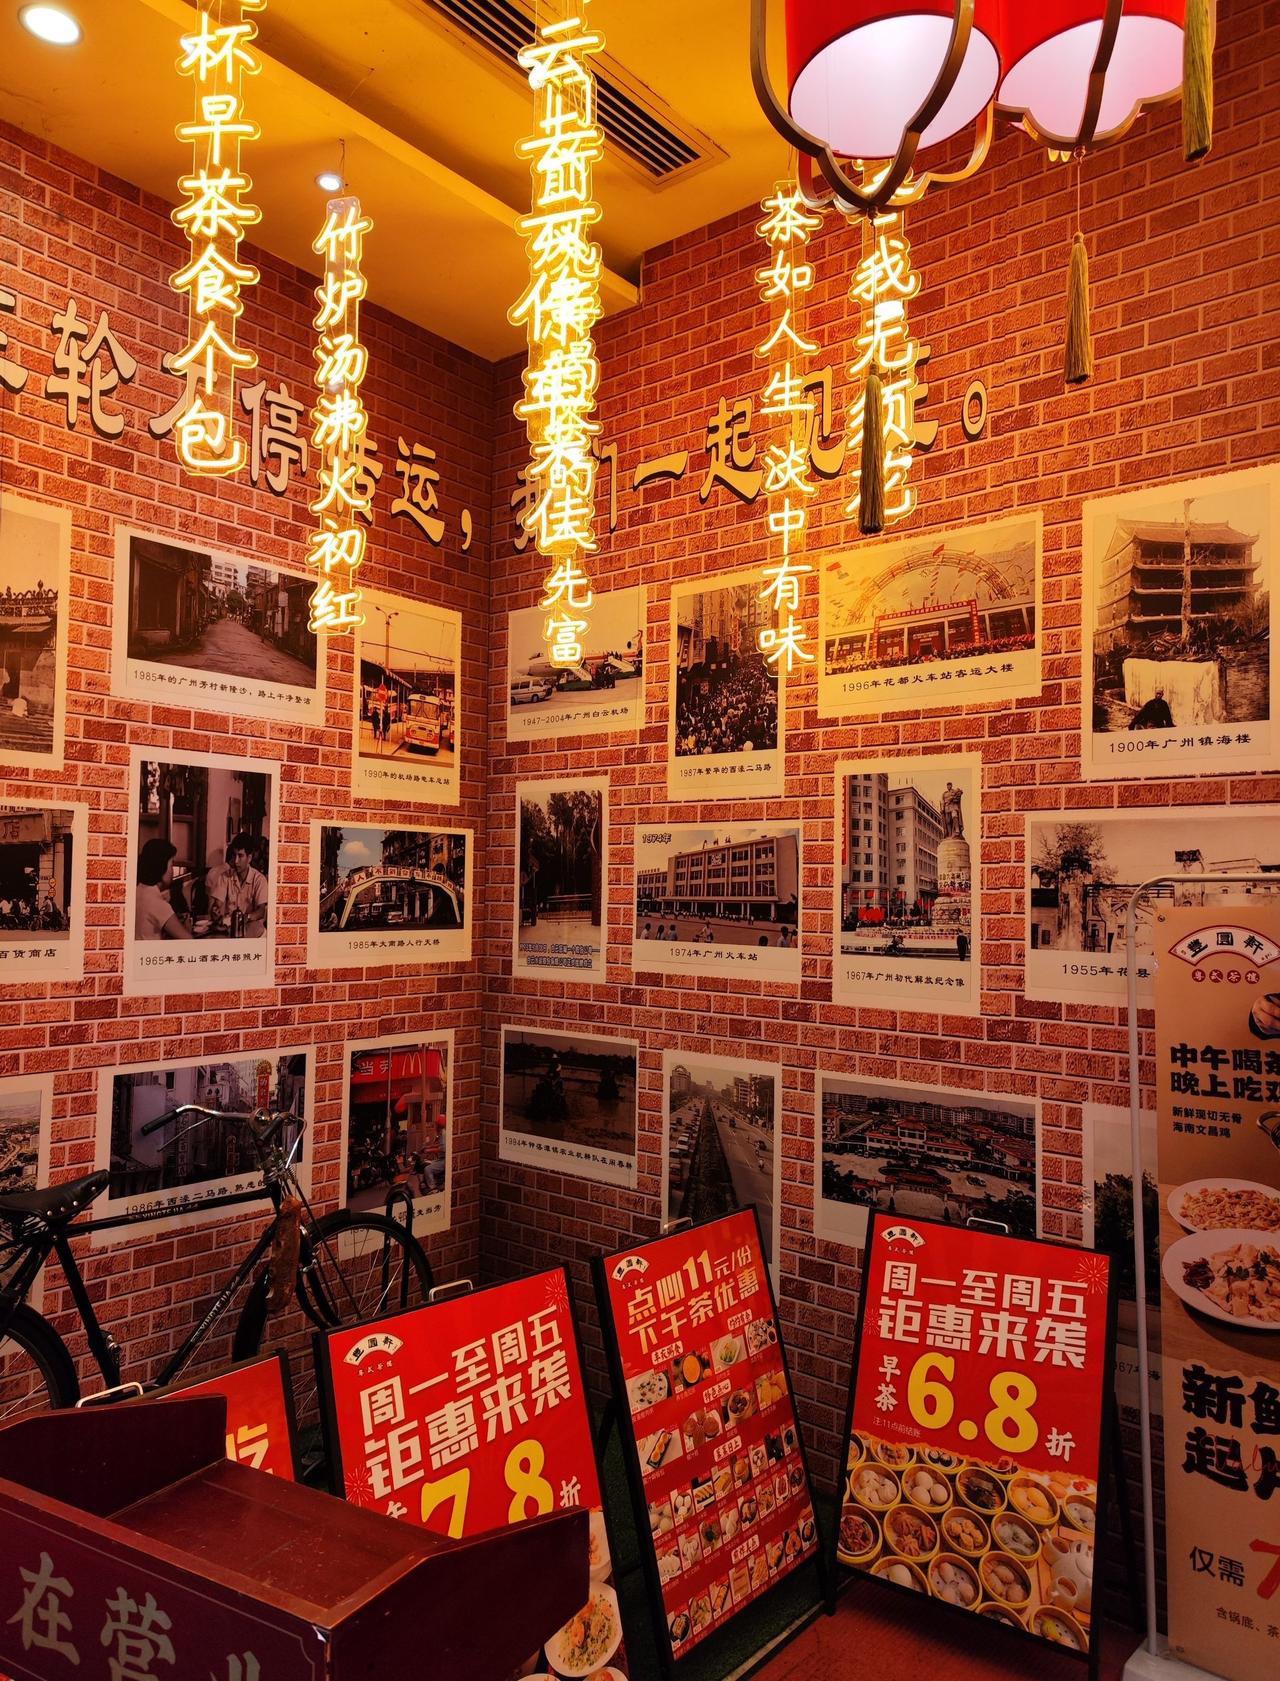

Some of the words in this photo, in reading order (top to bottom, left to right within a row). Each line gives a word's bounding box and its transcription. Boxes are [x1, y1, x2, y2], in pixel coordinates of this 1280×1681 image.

[172, 0, 258, 470] 杯早茶食个包
[0, 293, 472, 550] 轮不停转运，
[306, 206, 367, 630] 竹炉汤沸火初红
[756, 188, 821, 670] 茶如人生淡中有味
[842, 663, 1015, 692] 1996年花都火车站客运大楼
[523, 706, 629, 726] 1947-2004年广州白云机场
[1110, 734, 1251, 753] 1900年广州镇海楼
[140, 953, 262, 966] 1965年东山酒家内部照片
[348, 938, 440, 950] 1985年大南路人行天桥
[670, 948, 758, 961] 1974年广州火车站
[1172, 1106, 1242, 1124] 新鲜现切无骨
[1172, 1121, 1231, 1138] 海南文昌鸡
[629, 1266, 760, 1355] 下午茶优惠
[882, 1260, 1089, 1319] 周一至周五
[877, 1295, 1088, 1369] 钜惠来袭
[359, 1305, 563, 1437] 周一至周五
[363, 1349, 572, 1500] 钜惠来袭
[874, 1355, 901, 1412] 早茶
[907, 1352, 1039, 1453] 6.8
[1044, 1427, 1076, 1462] 折
[1188, 1545, 1246, 1588] 仅需
